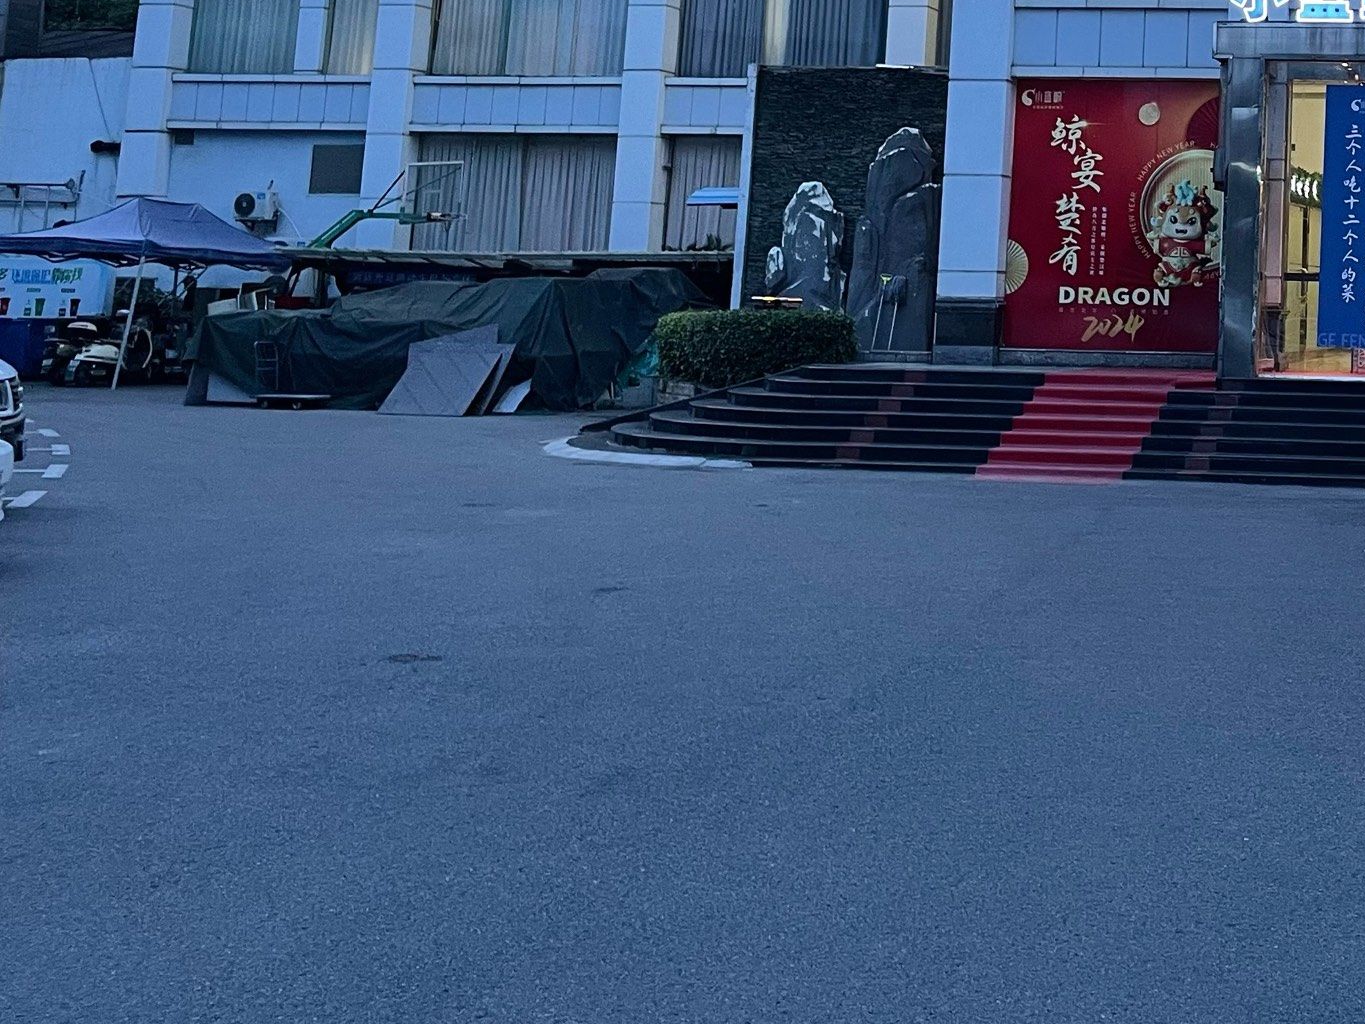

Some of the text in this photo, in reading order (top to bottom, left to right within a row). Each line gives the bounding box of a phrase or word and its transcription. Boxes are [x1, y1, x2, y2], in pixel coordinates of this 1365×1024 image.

[1137, 158, 1155, 182] HAPPY
[1156, 146, 1174, 160] NEW
[1341, 124, 1362, 303] 三个人吃十二个人的菜
[1058, 286, 1170, 306] DRAGON
[1081, 310, 1145, 343] 2024
